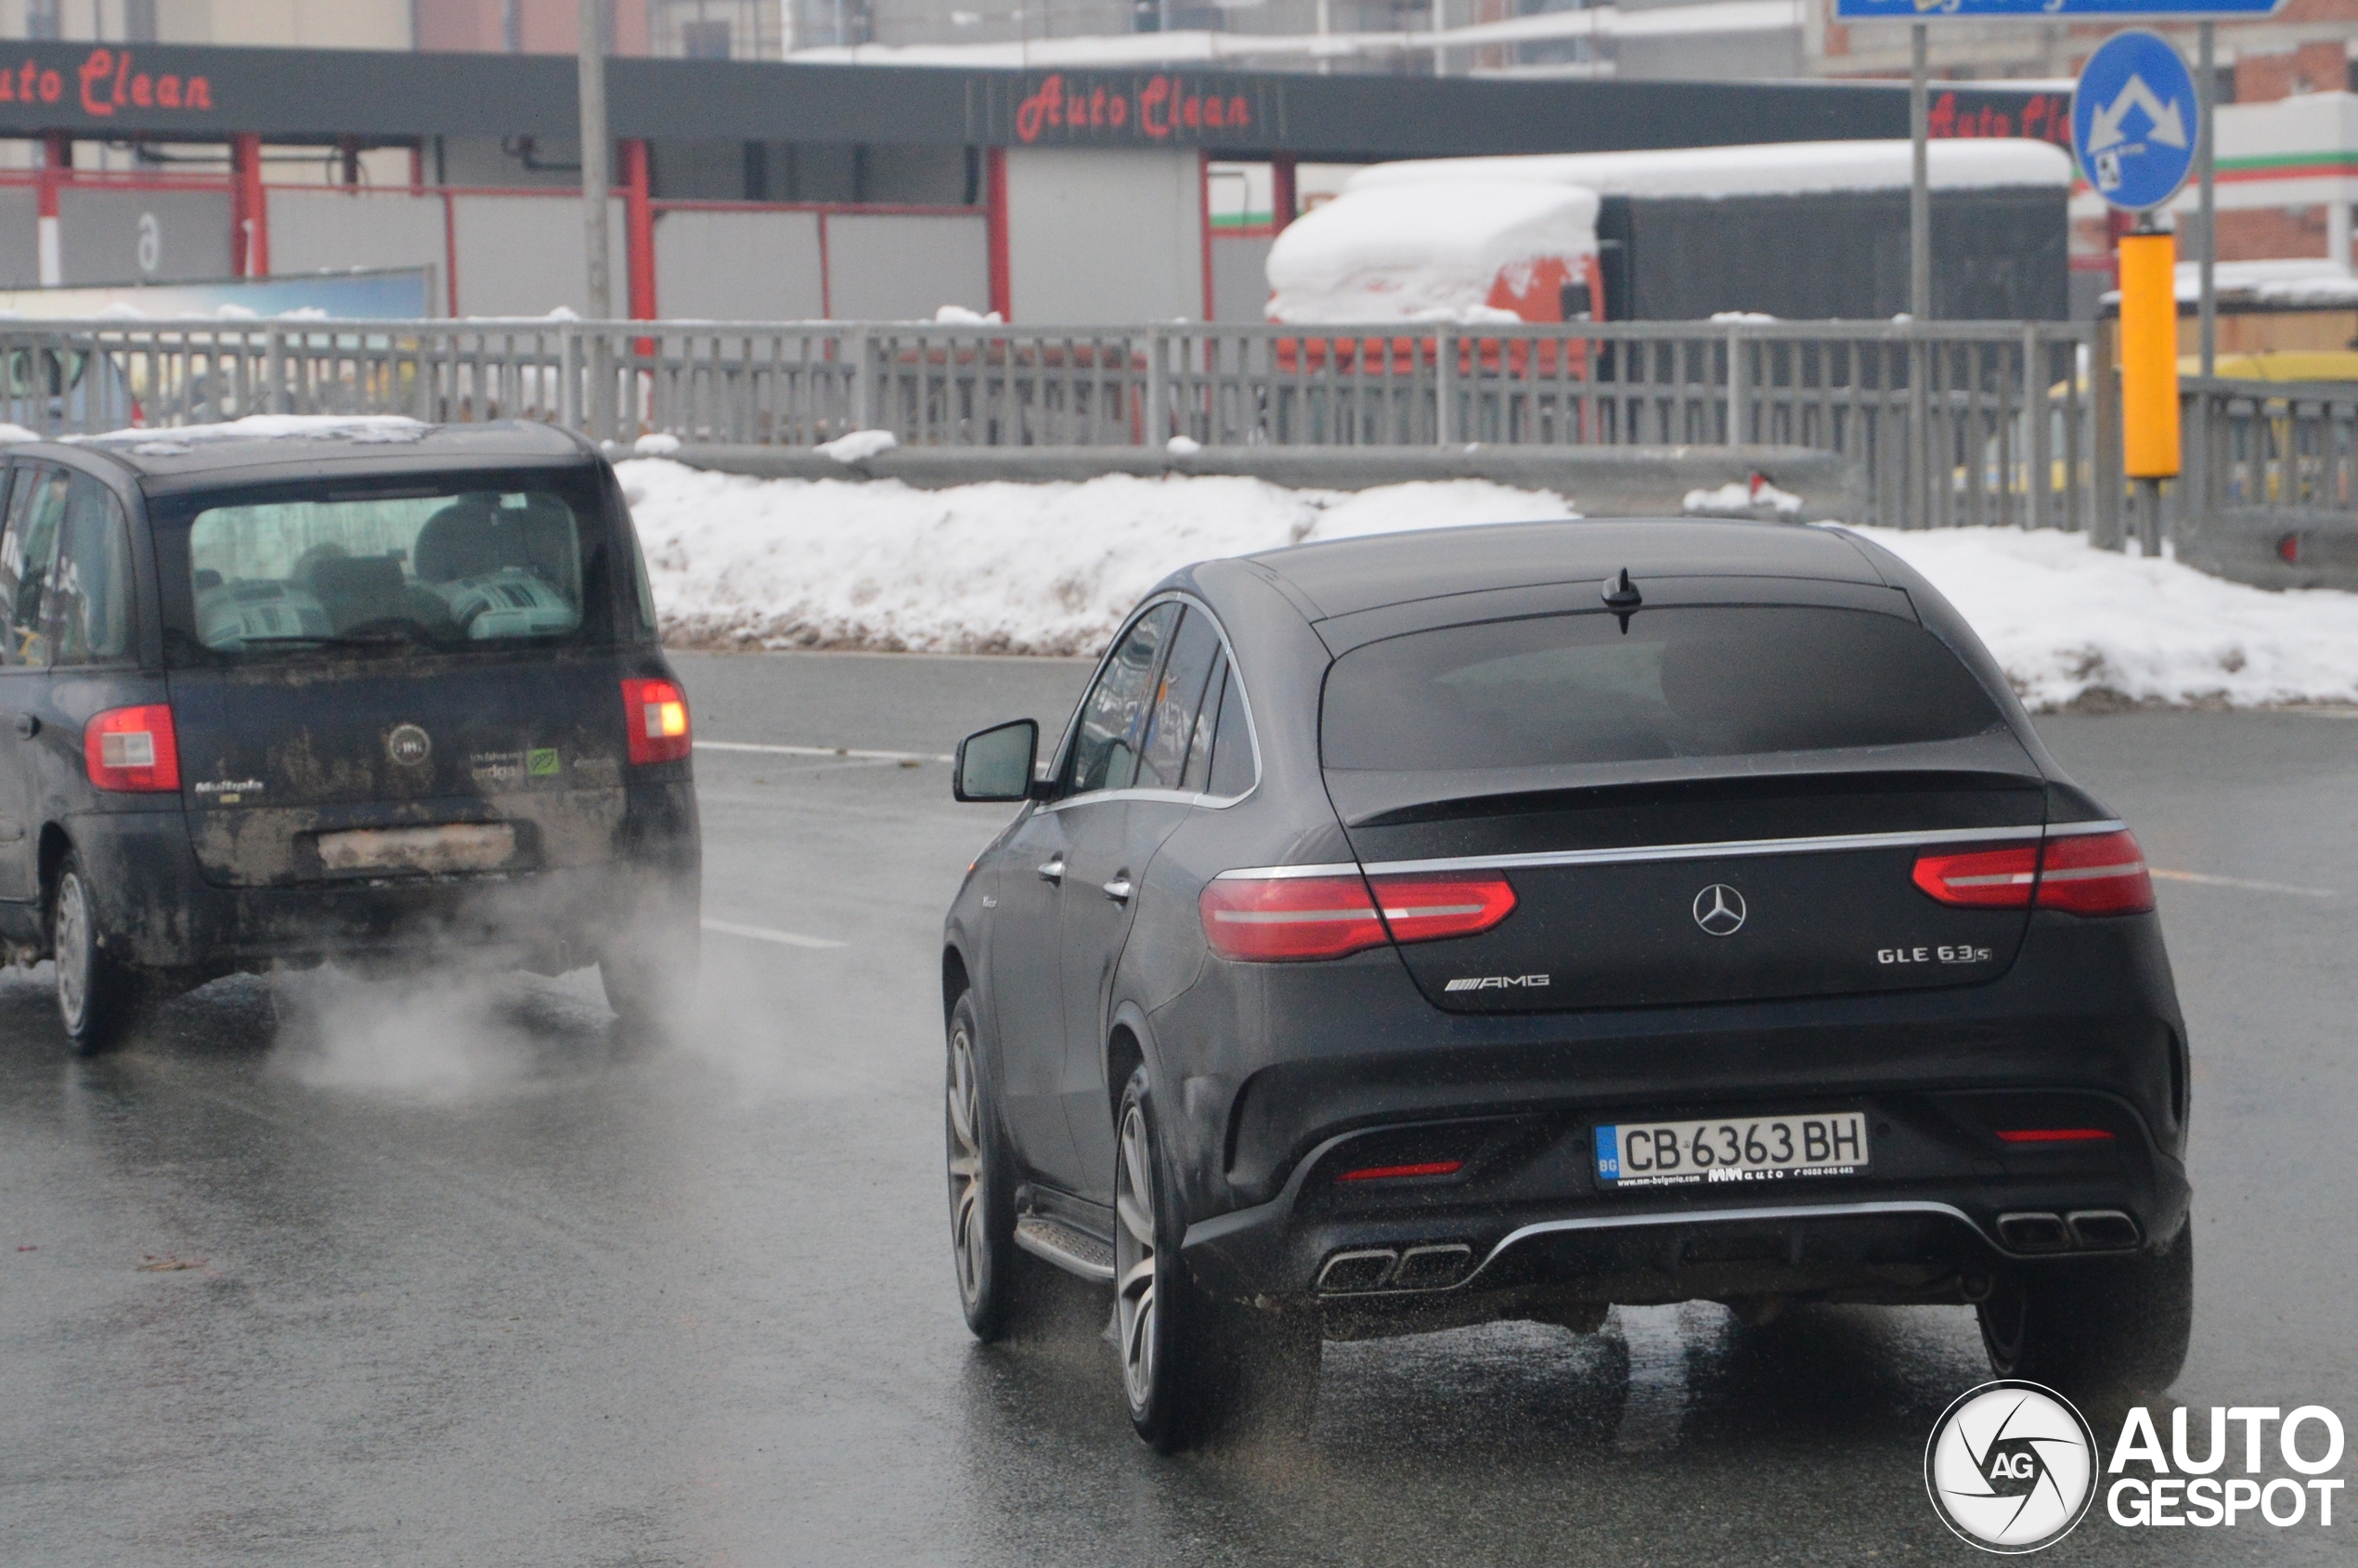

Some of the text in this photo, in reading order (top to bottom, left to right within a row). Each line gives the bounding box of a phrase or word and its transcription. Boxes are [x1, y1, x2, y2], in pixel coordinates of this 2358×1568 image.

[78, 48, 212, 116] Clean
[1017, 74, 1250, 143] Auto Clean
[1877, 947, 1930, 965] GLE
[1477, 974, 1550, 990] AMG
[1625, 1119, 1860, 1172] CB 6363 BH
[1599, 1159, 1618, 1173] BG
[1617, 1174, 1701, 1187] www.mm-bulgaria.com
